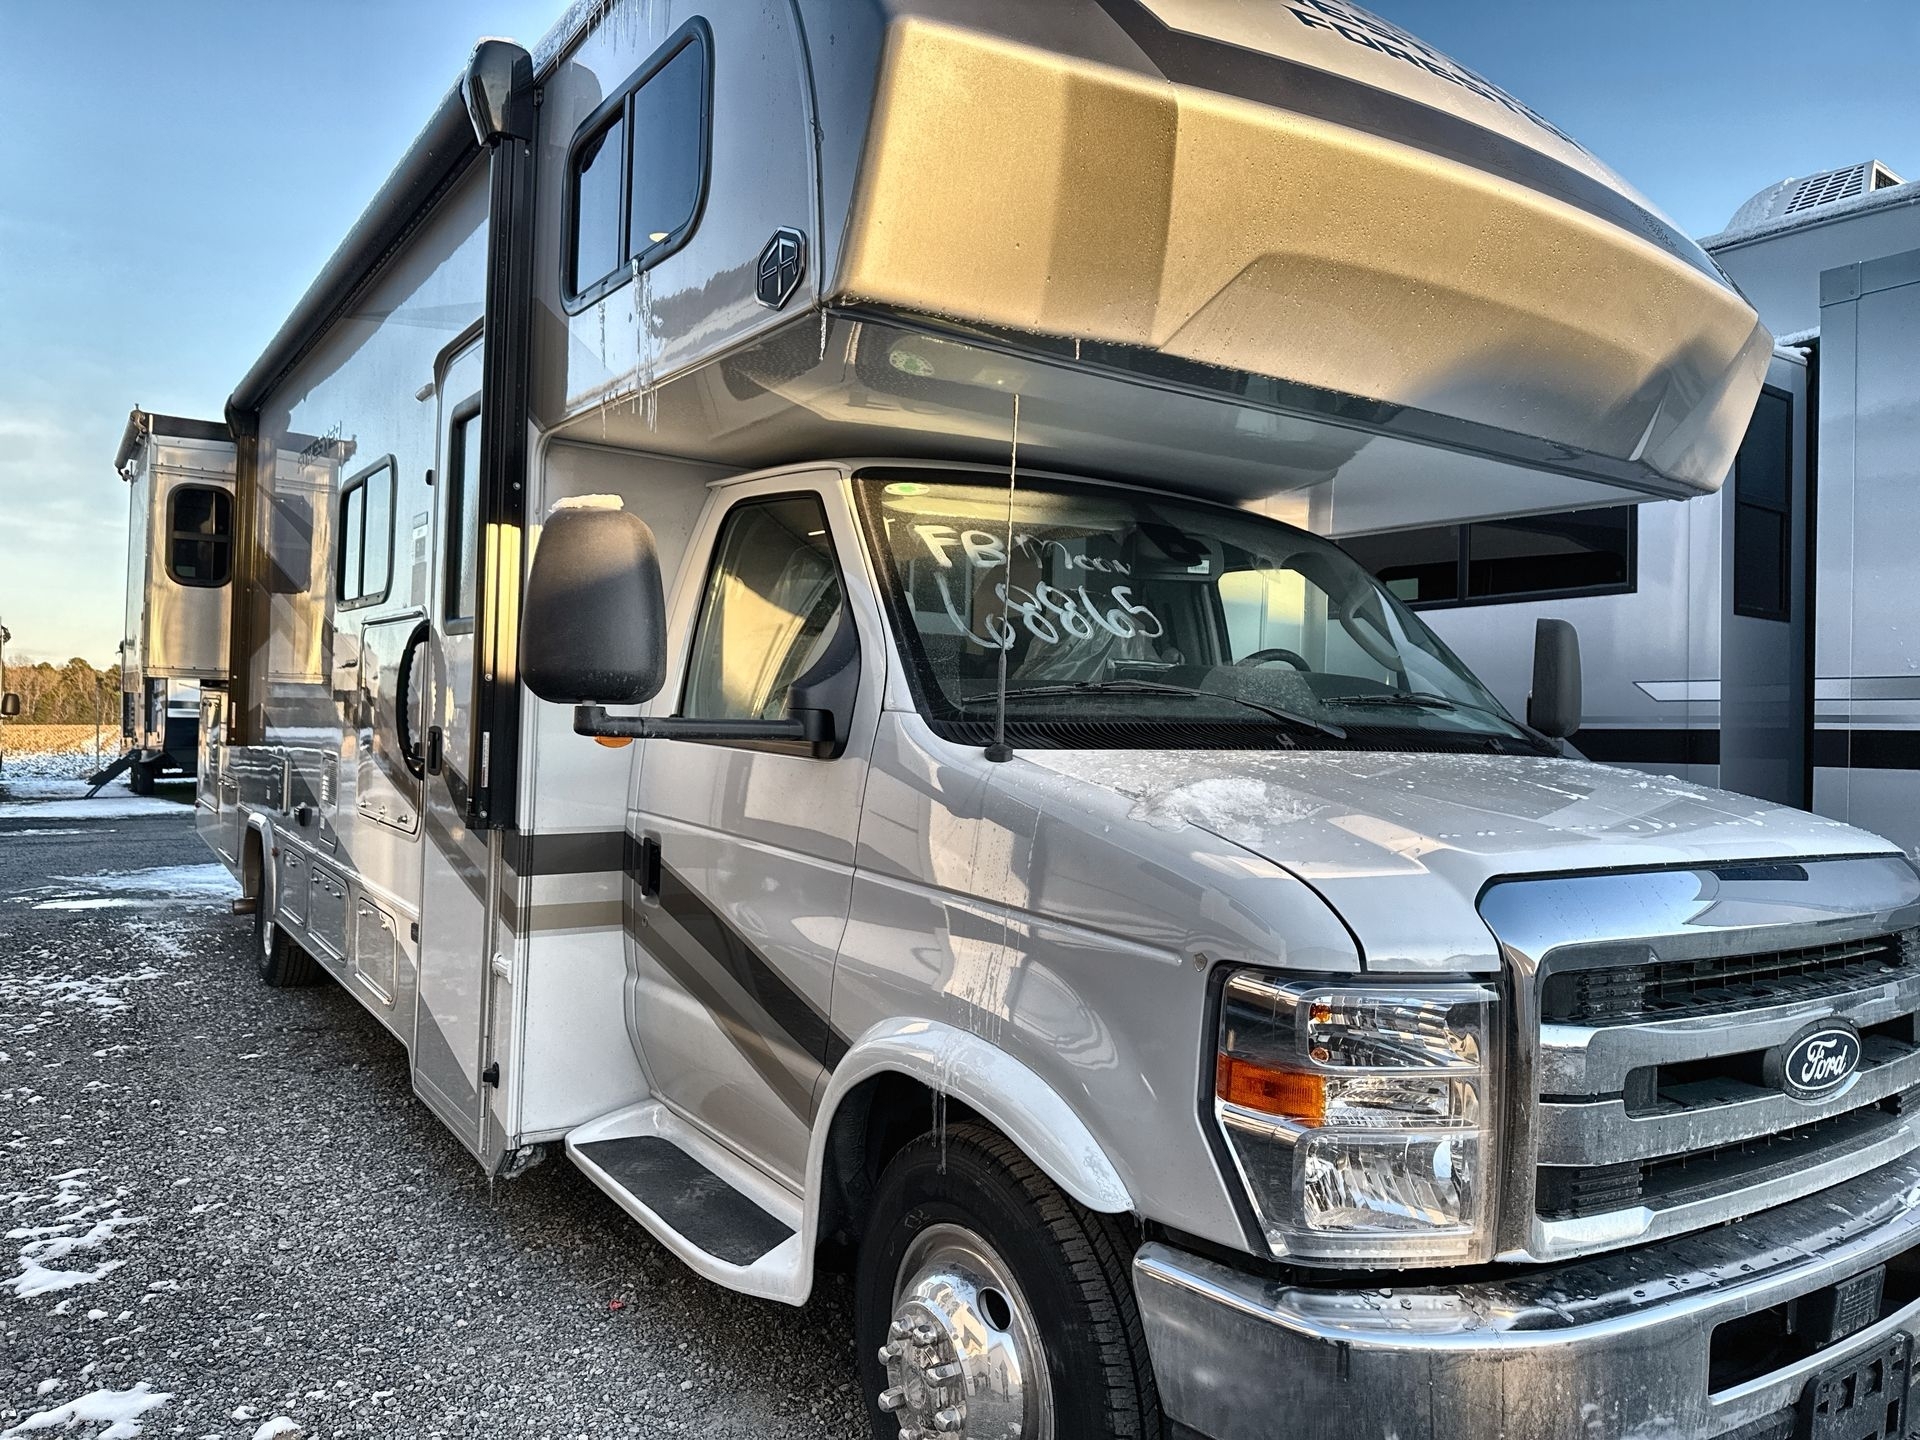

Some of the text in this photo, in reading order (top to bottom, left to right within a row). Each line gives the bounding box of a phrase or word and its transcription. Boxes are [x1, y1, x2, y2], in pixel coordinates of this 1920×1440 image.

[1281, 4, 1588, 155] FORESTER
[933, 571, 1164, 651] 68865
[1801, 1038, 1848, 1083] Ford
